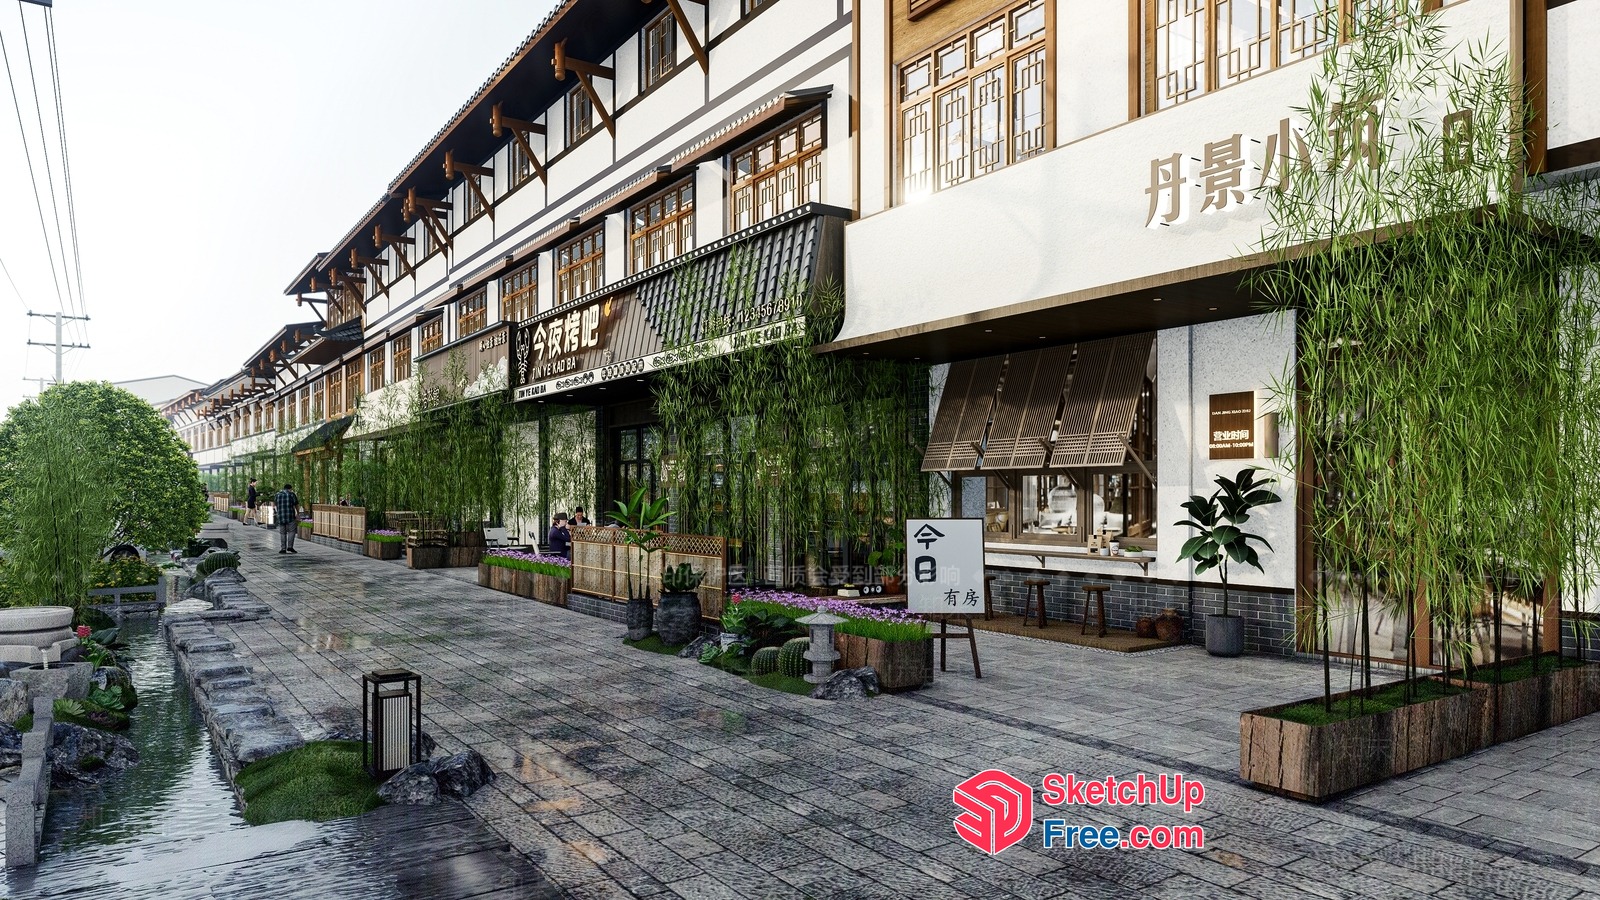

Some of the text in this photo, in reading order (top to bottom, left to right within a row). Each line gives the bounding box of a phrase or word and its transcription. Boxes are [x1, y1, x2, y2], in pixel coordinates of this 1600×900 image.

[533, 303, 600, 360] 今夜烤吧
[532, 357, 576, 380] JIN YE KAO BA
[525, 387, 531, 398] YE
[531, 385, 540, 396] KAO
[540, 384, 547, 394] BA
[1213, 430, 1249, 441] 营业时间
[913, 523, 946, 584] 今日
[943, 588, 980, 607] 有房
